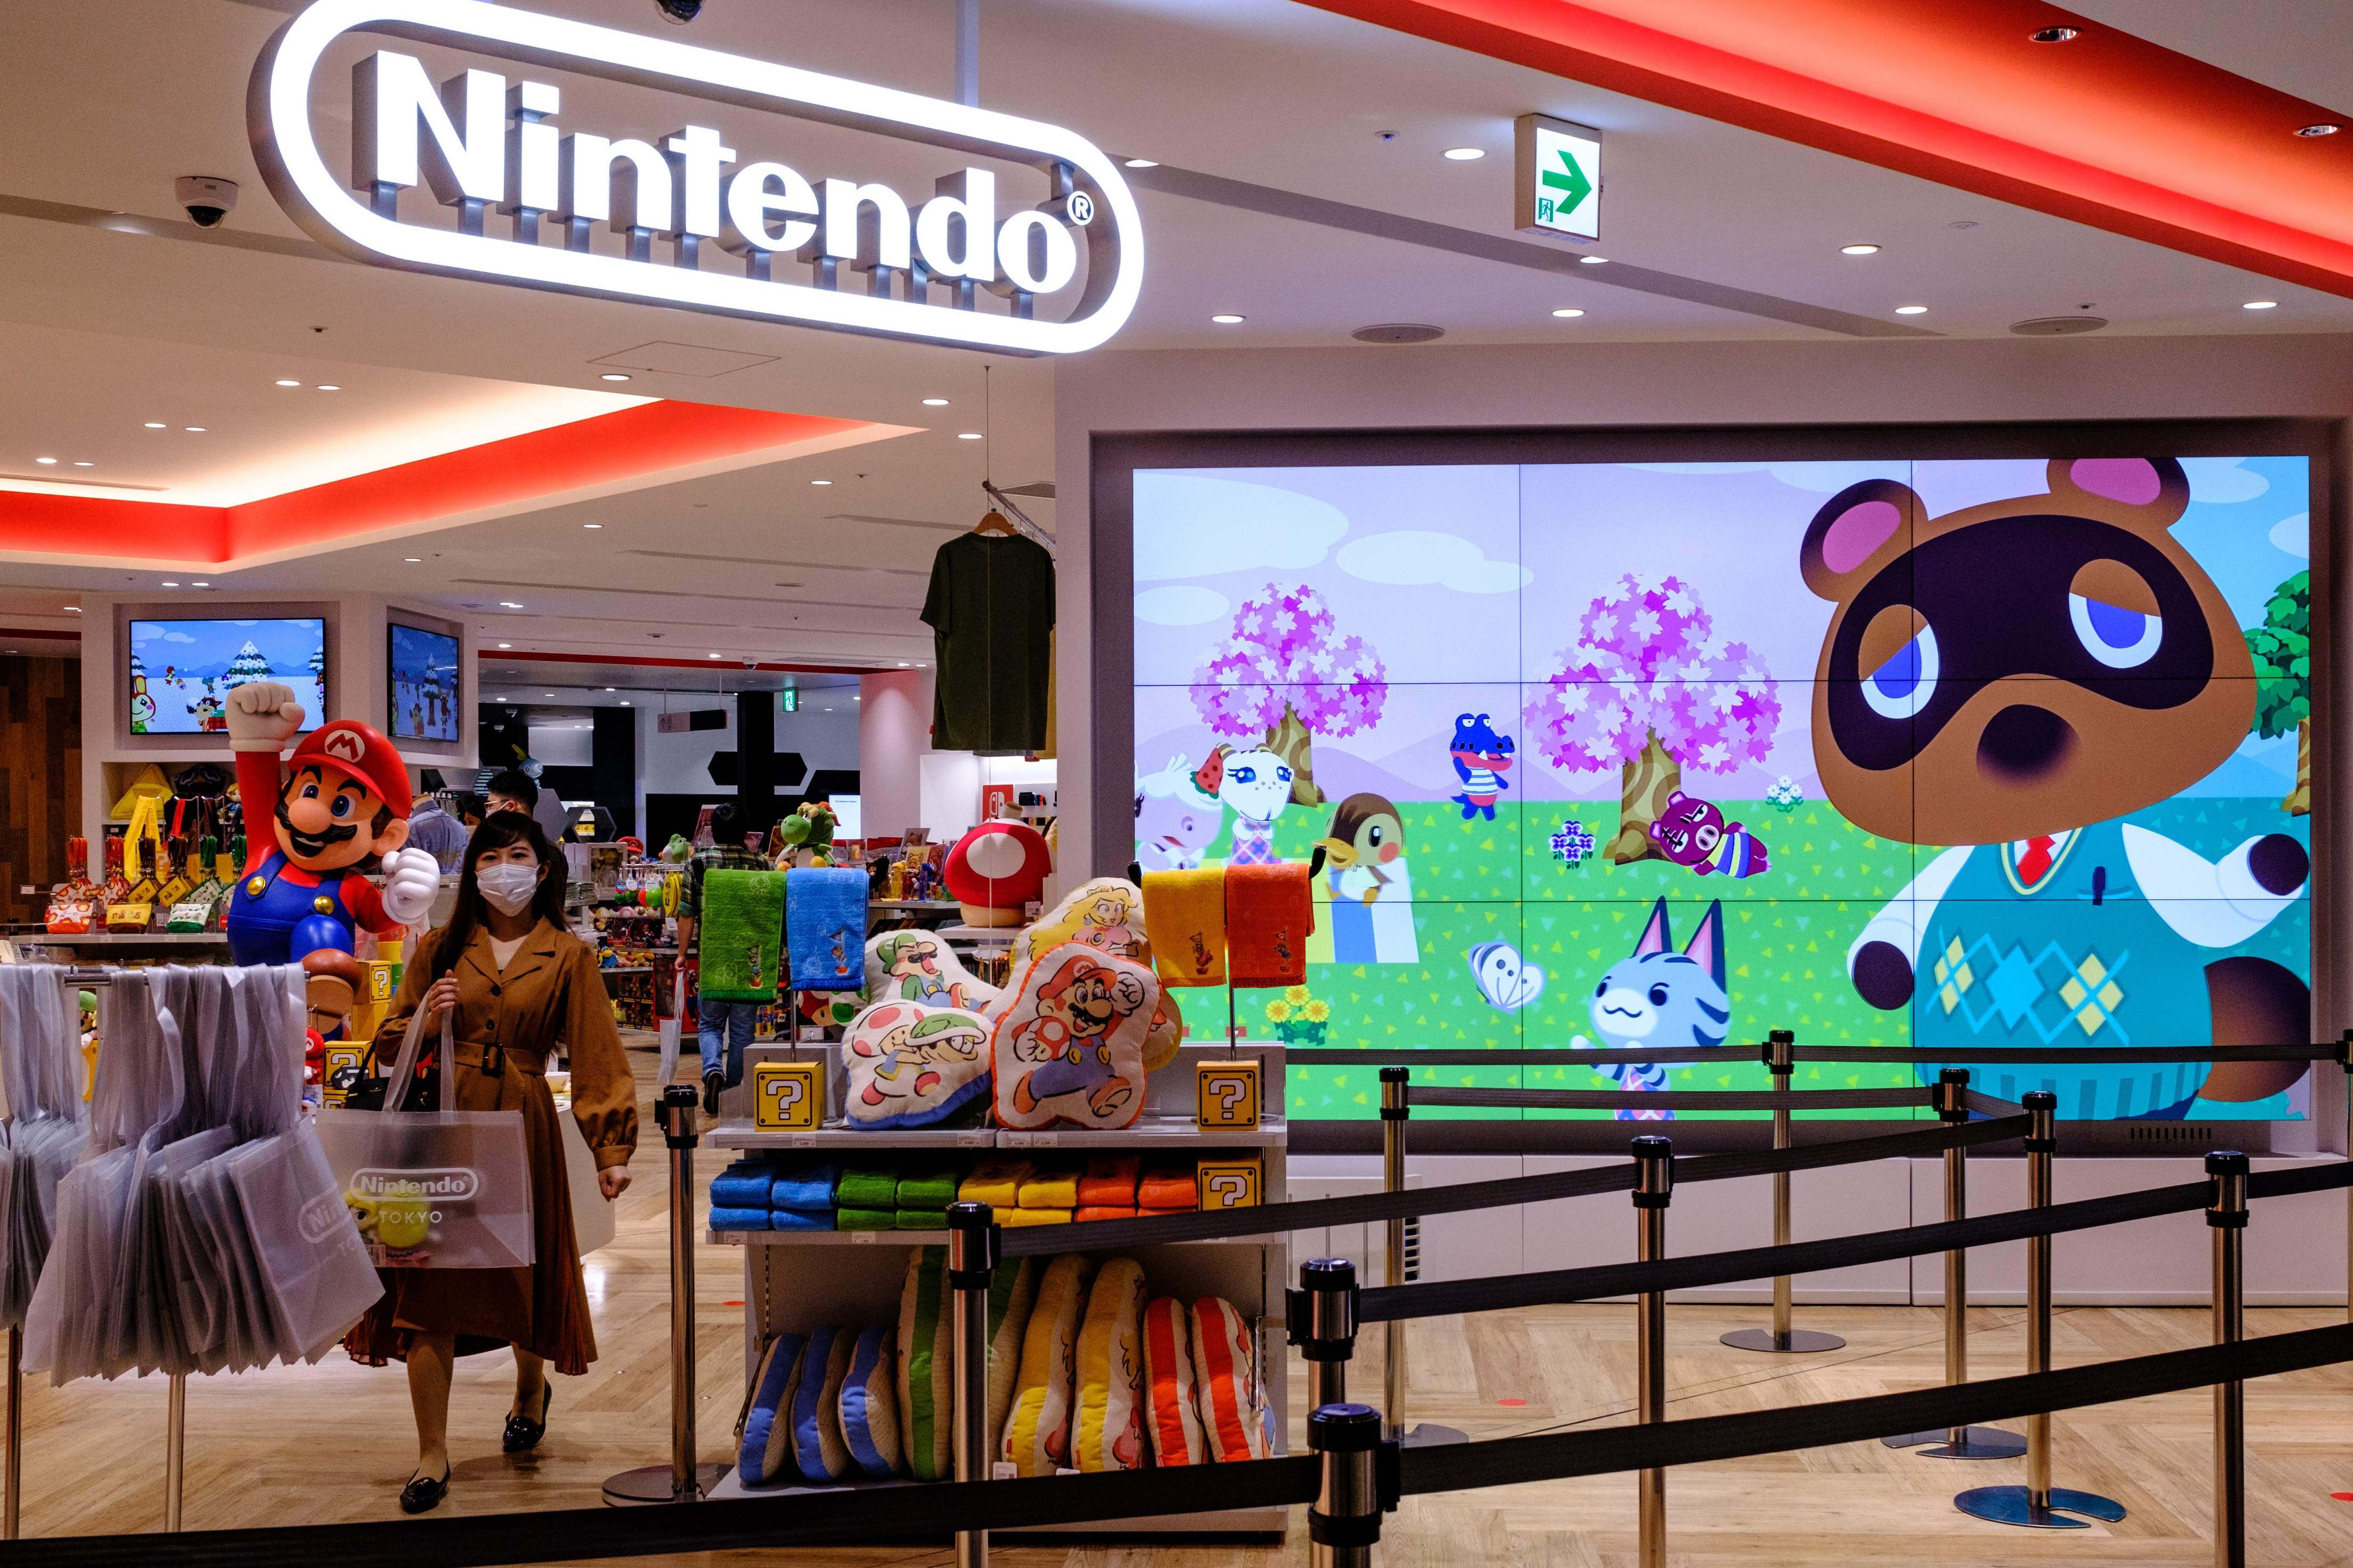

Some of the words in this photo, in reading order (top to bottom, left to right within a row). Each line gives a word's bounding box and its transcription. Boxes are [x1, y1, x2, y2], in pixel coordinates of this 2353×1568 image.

[326, 733, 359, 760] M
[374, 969, 388, 996] ?
[766, 1079, 803, 1120] ?
[1209, 1078, 1246, 1120] ?
[378, 1210, 442, 1224] TOKYO
